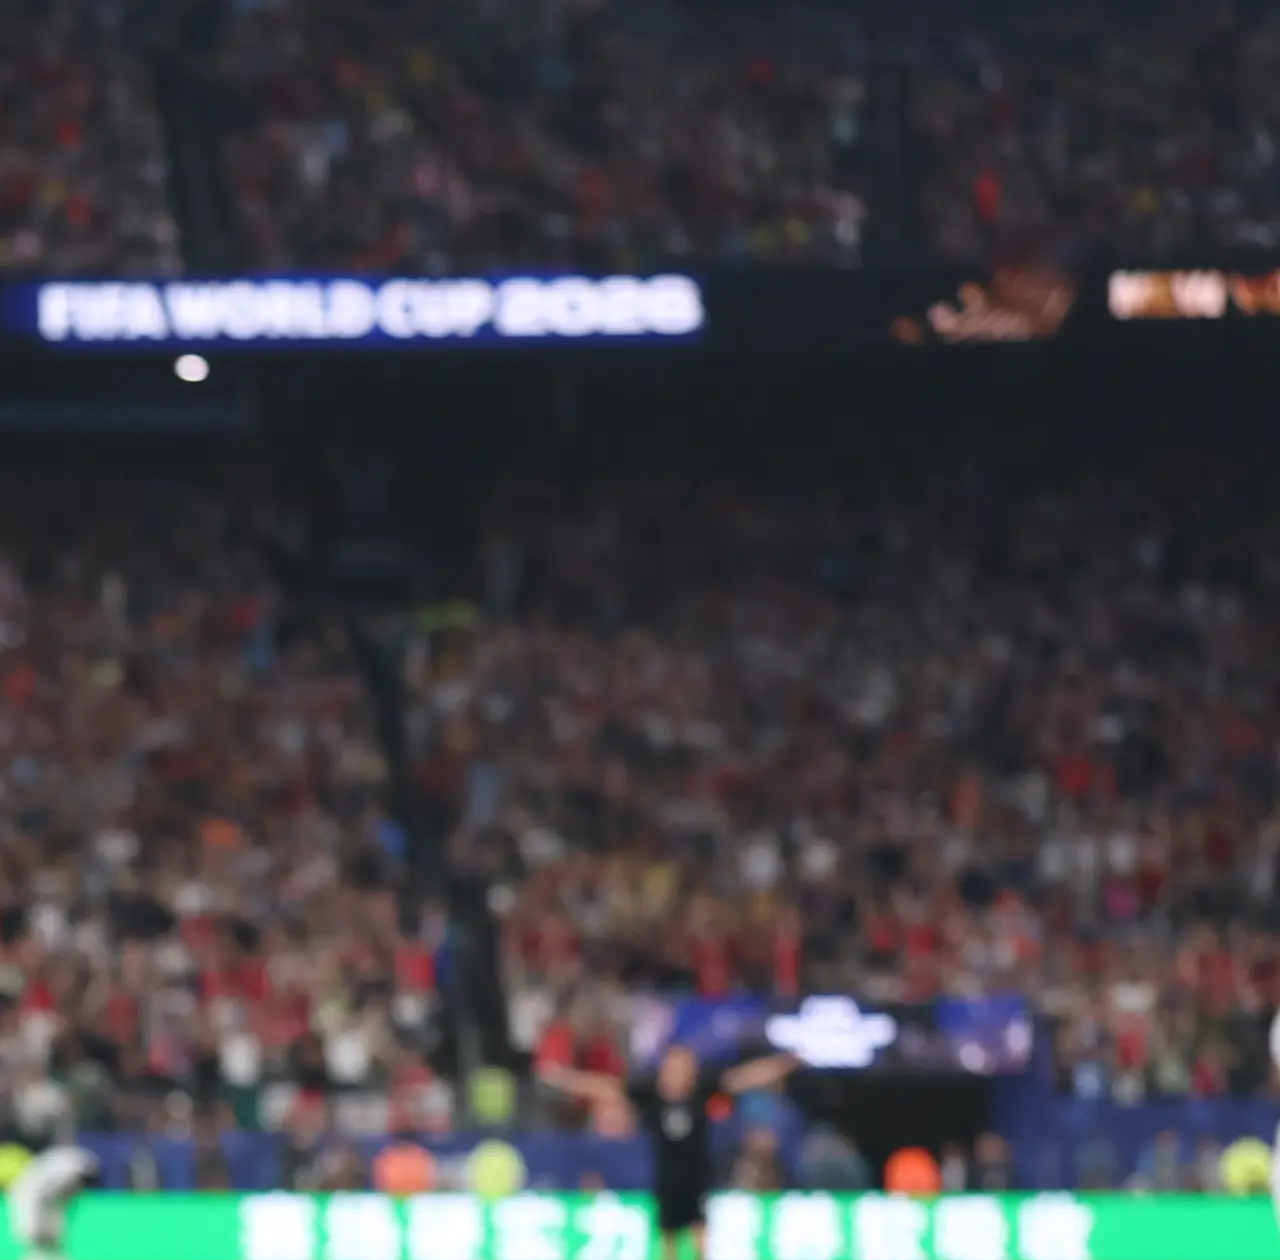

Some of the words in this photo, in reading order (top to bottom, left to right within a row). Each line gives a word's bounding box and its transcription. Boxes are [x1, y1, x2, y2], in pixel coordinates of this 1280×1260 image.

[37, 281, 168, 342] FIFA
[165, 278, 375, 340] WORLD
[376, 276, 494, 338] CUP
